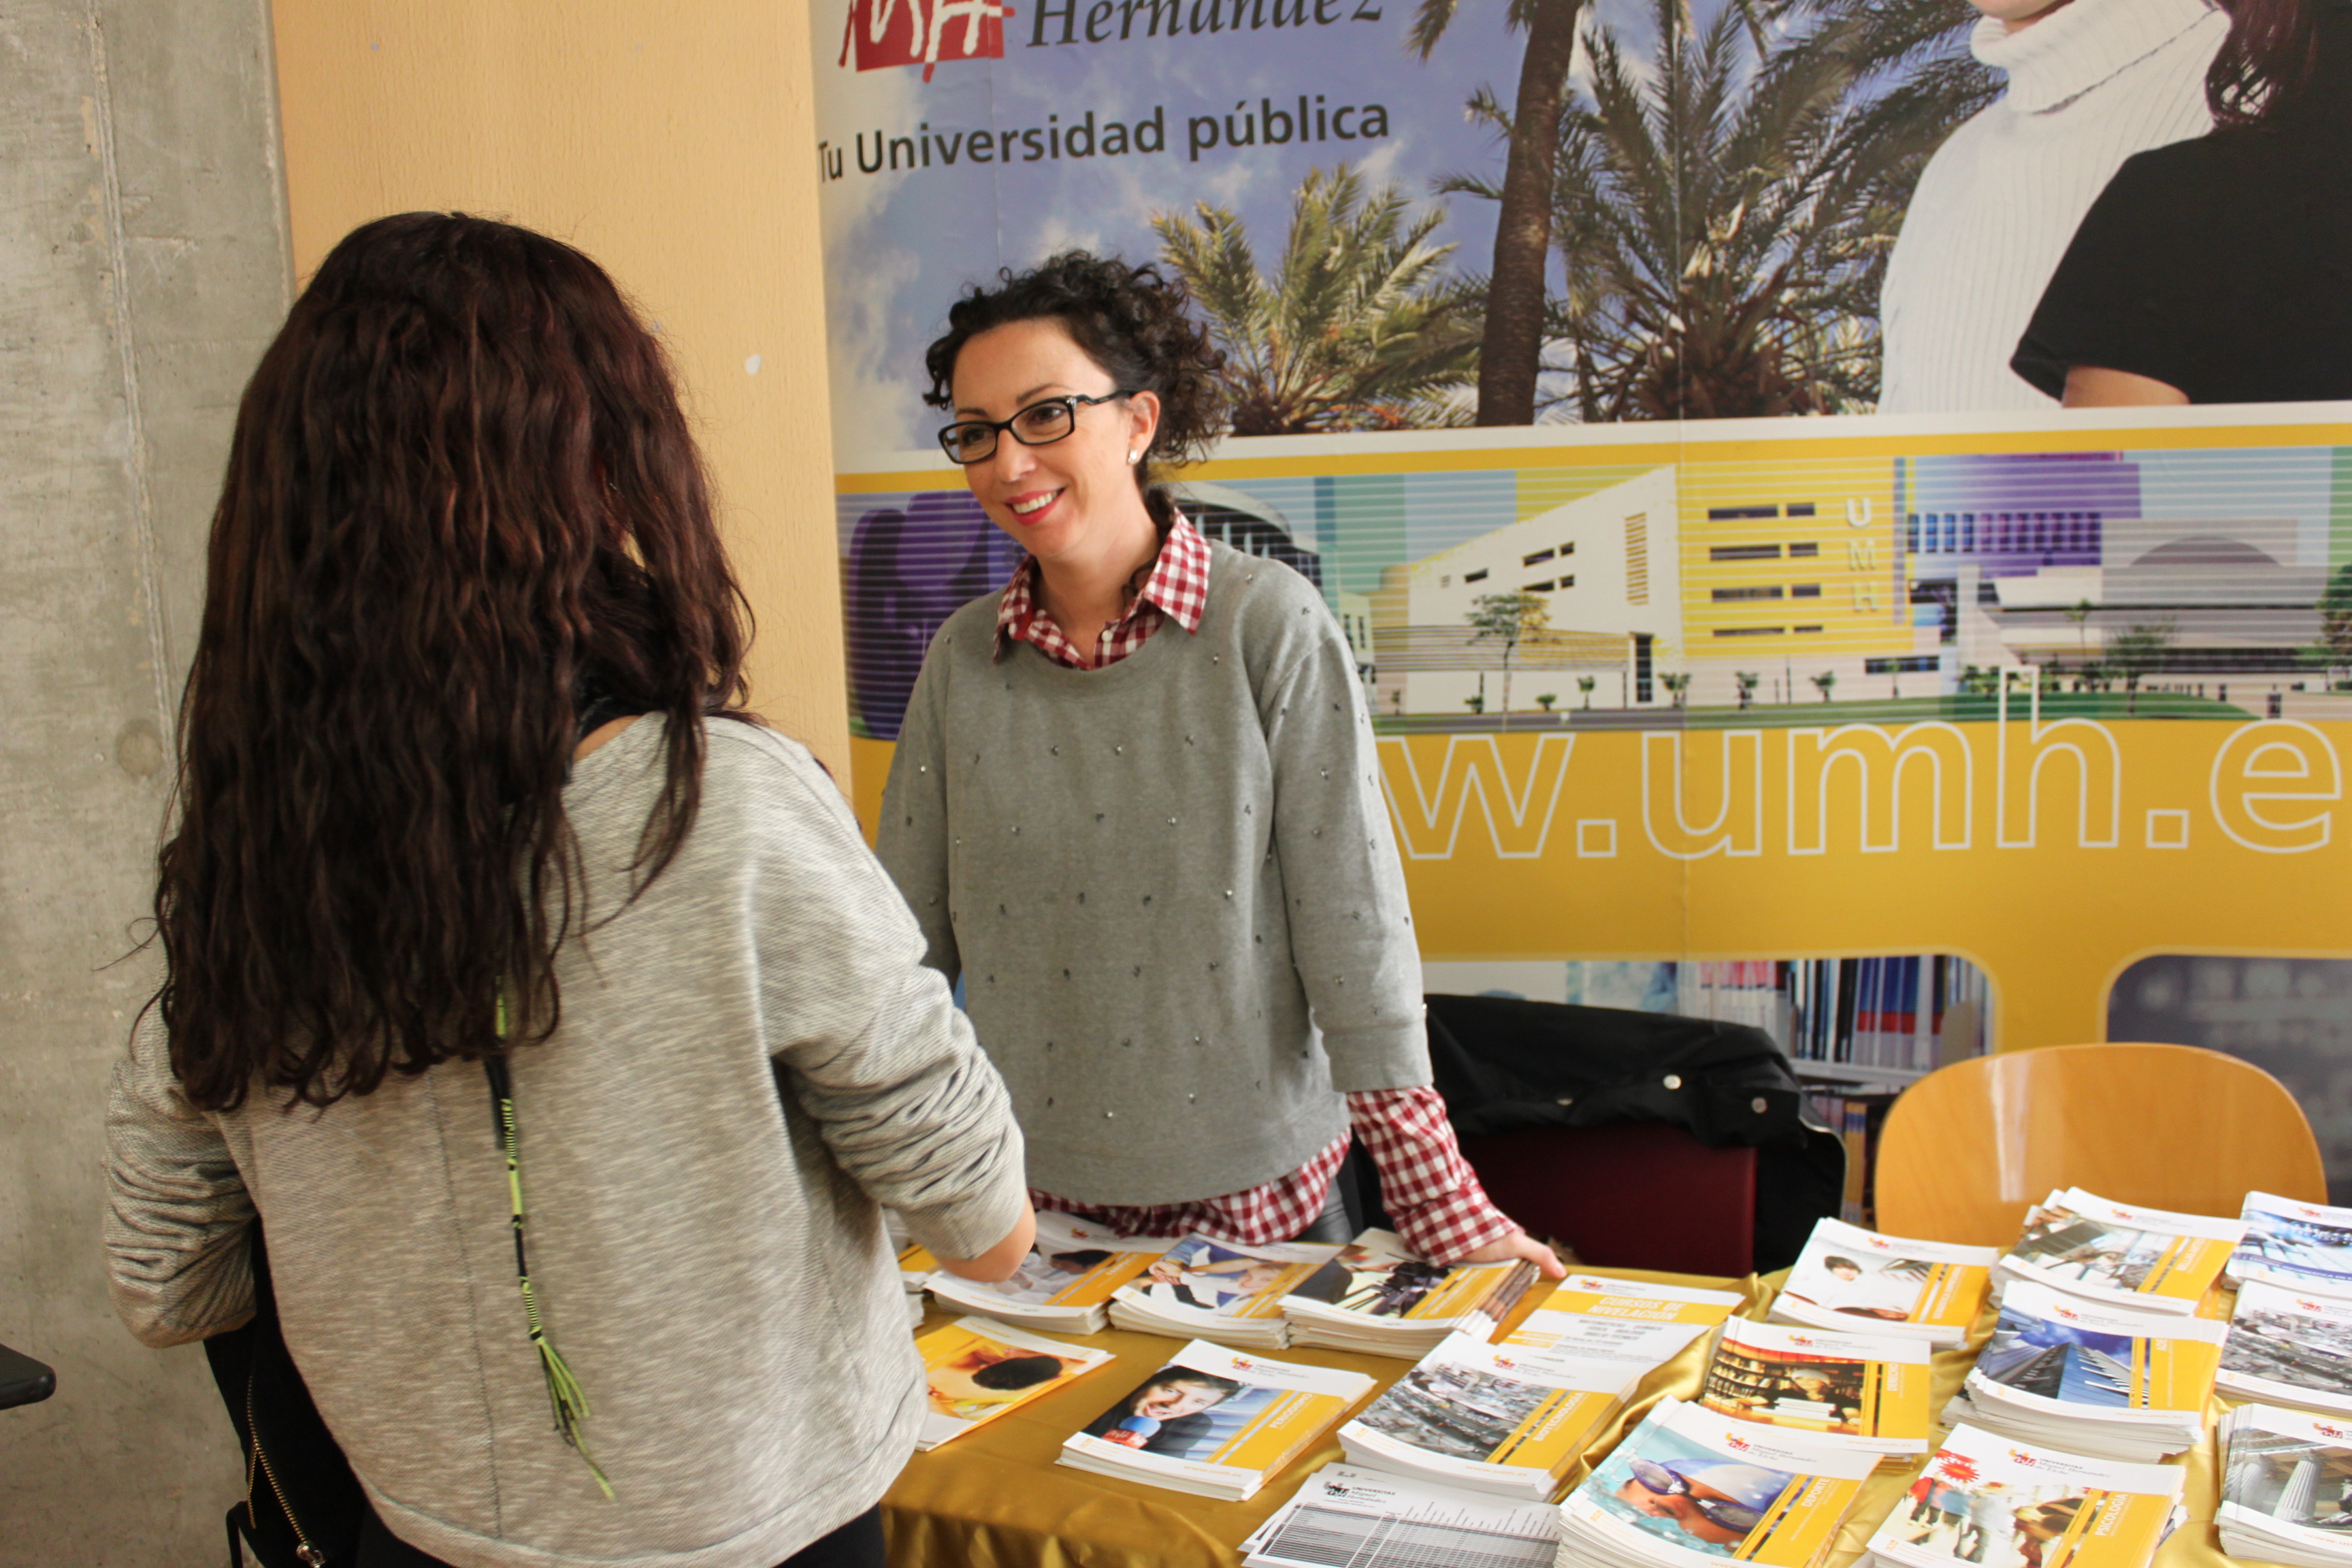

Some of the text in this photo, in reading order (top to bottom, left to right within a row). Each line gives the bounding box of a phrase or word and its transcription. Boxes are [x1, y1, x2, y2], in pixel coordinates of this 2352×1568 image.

[818, 95, 1388, 182] Tu Universidad pública
[1375, 665, 2352, 860] w.umh.e
[1269, 1392, 1313, 1429] PERIODISMO
[1801, 1477, 1831, 1507] DEPORTE
[2094, 1494, 2128, 1537] PSICOLOGÍA
